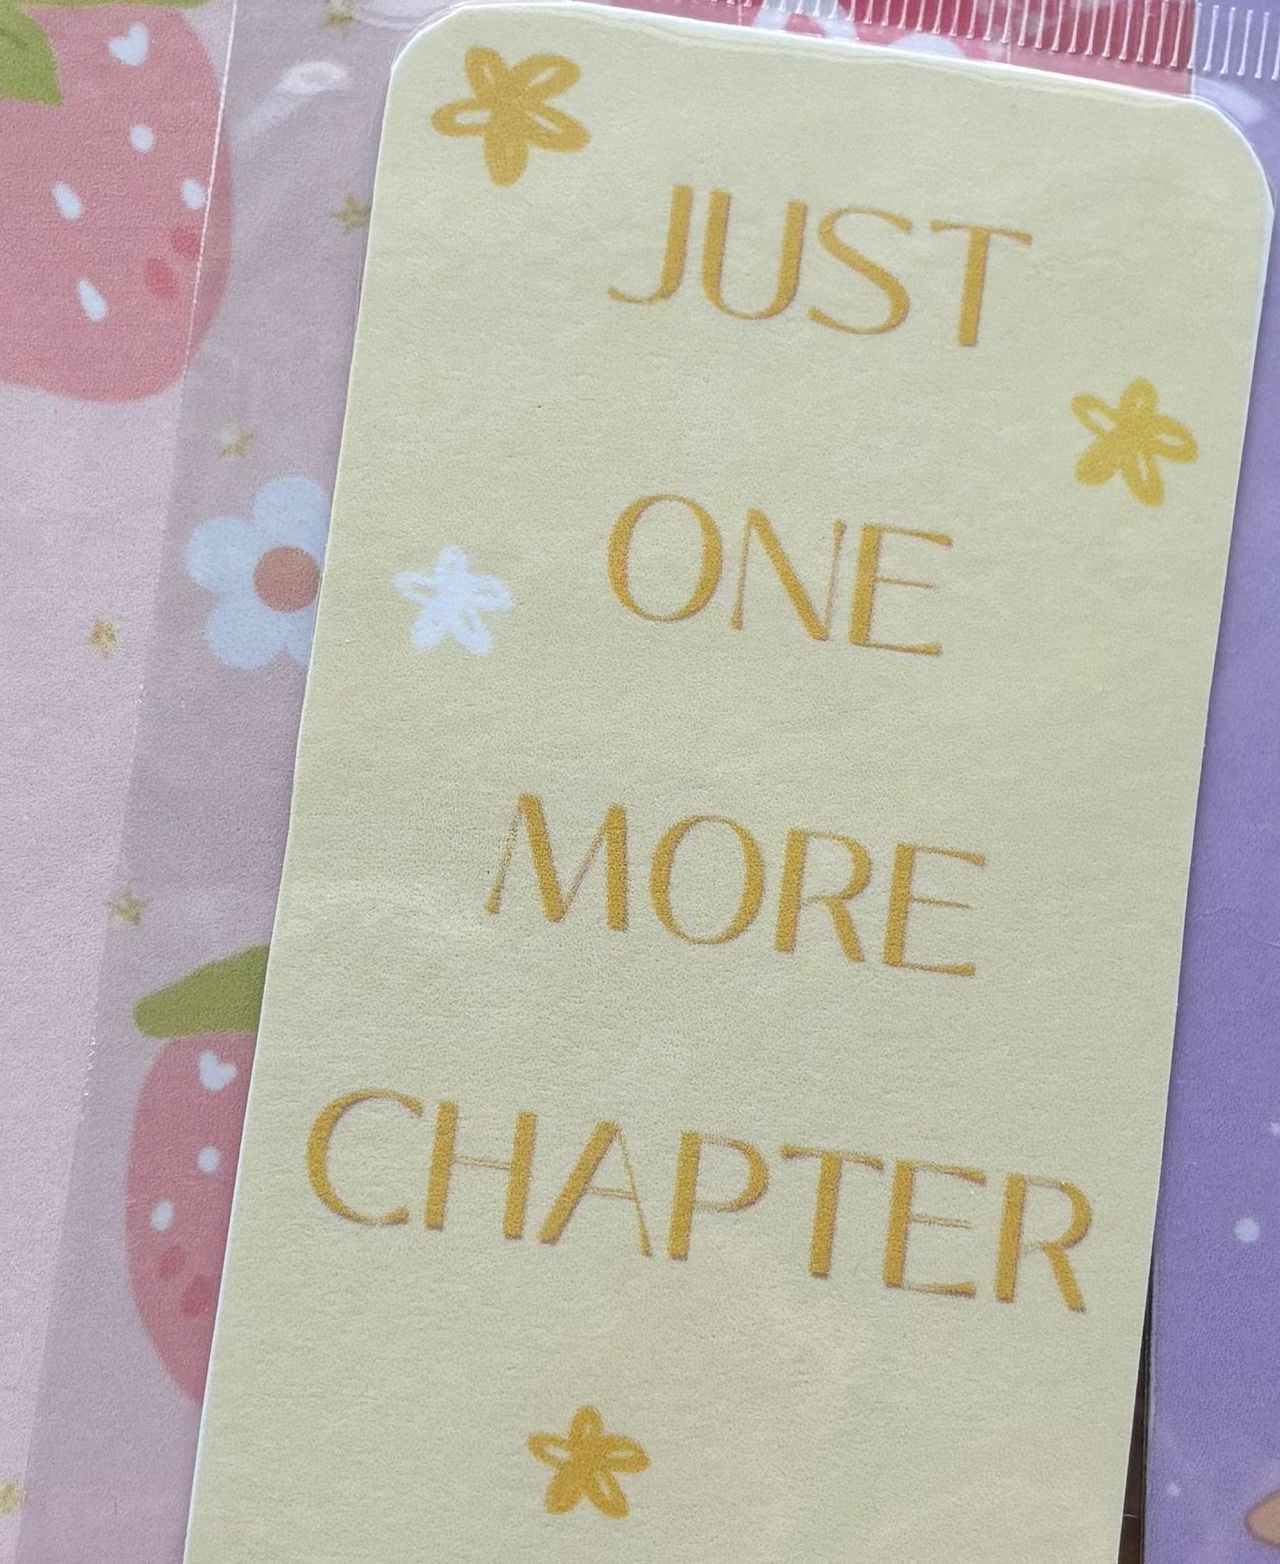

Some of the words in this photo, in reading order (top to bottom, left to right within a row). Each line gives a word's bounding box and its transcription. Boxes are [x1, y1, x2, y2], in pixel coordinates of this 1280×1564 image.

[606, 183, 1033, 348] JUST
[606, 492, 954, 657] ONE
[484, 792, 987, 978] MORE
[305, 1087, 1094, 1313] CHAPTER
